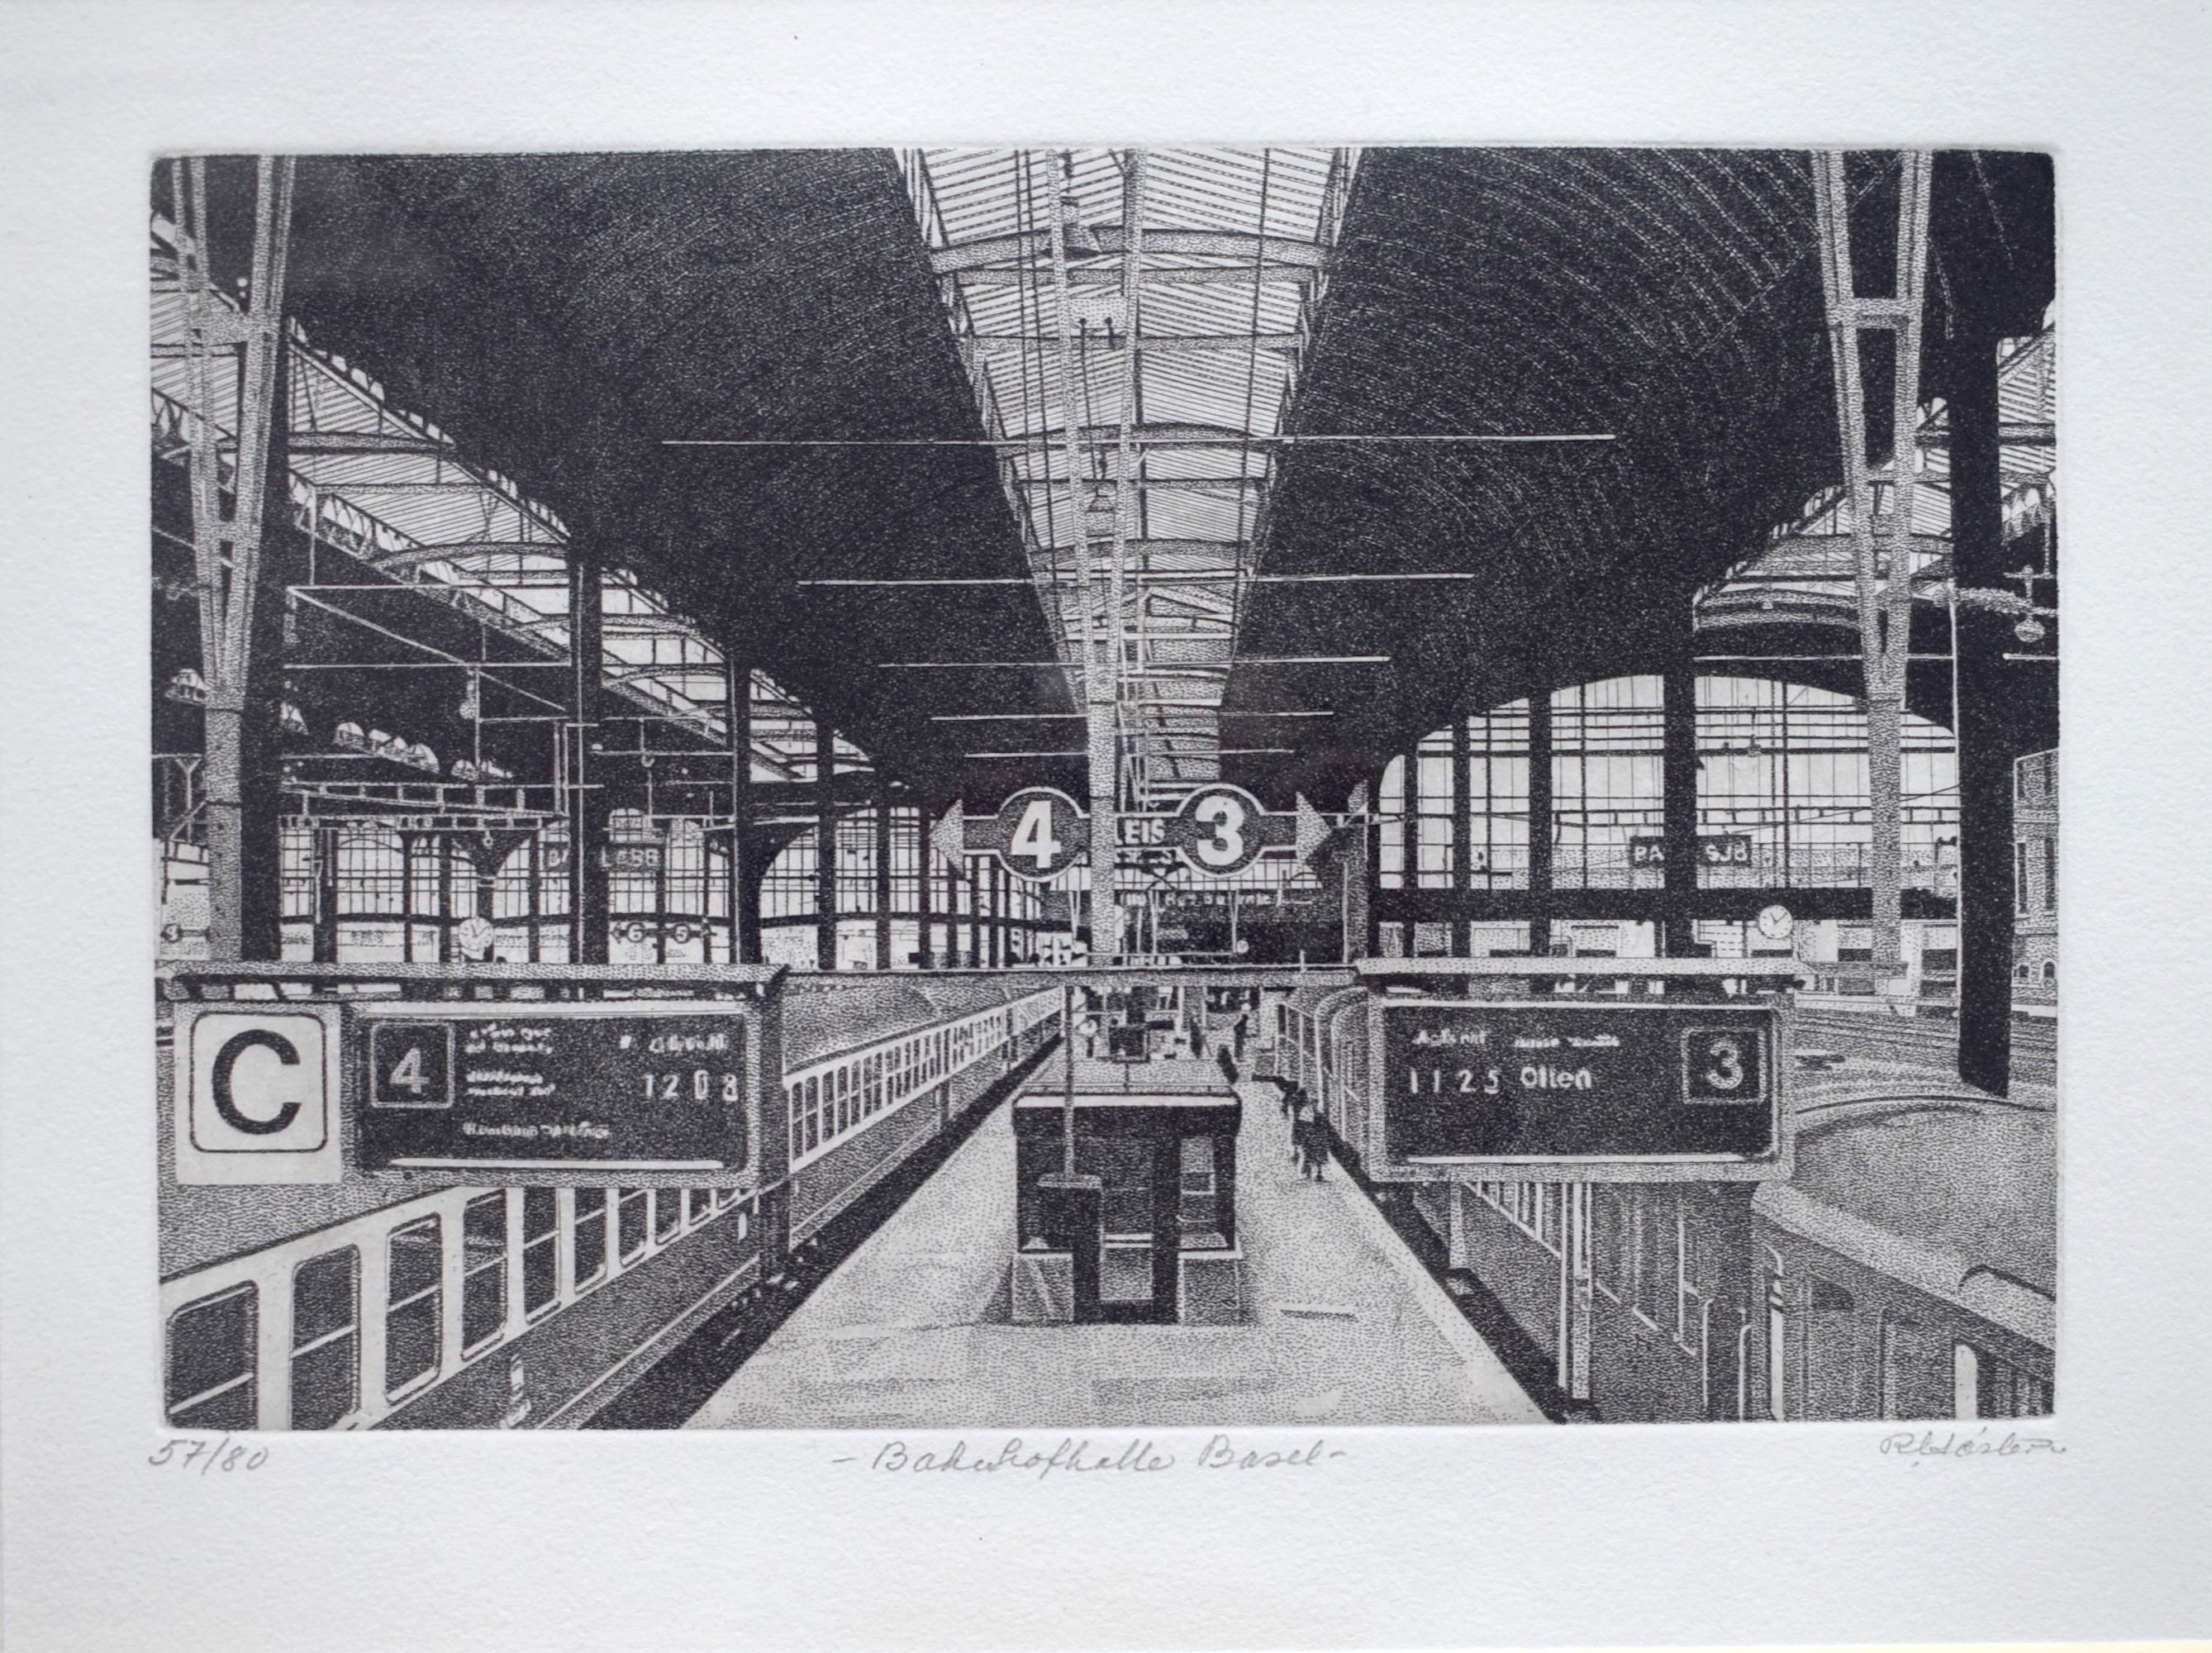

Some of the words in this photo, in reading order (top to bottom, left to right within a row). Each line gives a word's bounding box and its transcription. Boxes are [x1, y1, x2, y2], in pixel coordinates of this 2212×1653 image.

[1011, 800, 1062, 869] 4
[1195, 794, 1245, 866] 3
[212, 1028, 302, 1136] C
[388, 1047, 431, 1094] 4
[1520, 1066, 1592, 1090] Olten
[1707, 1039, 1743, 1090] 3
[148, 1437, 269, 1475] 57/80
